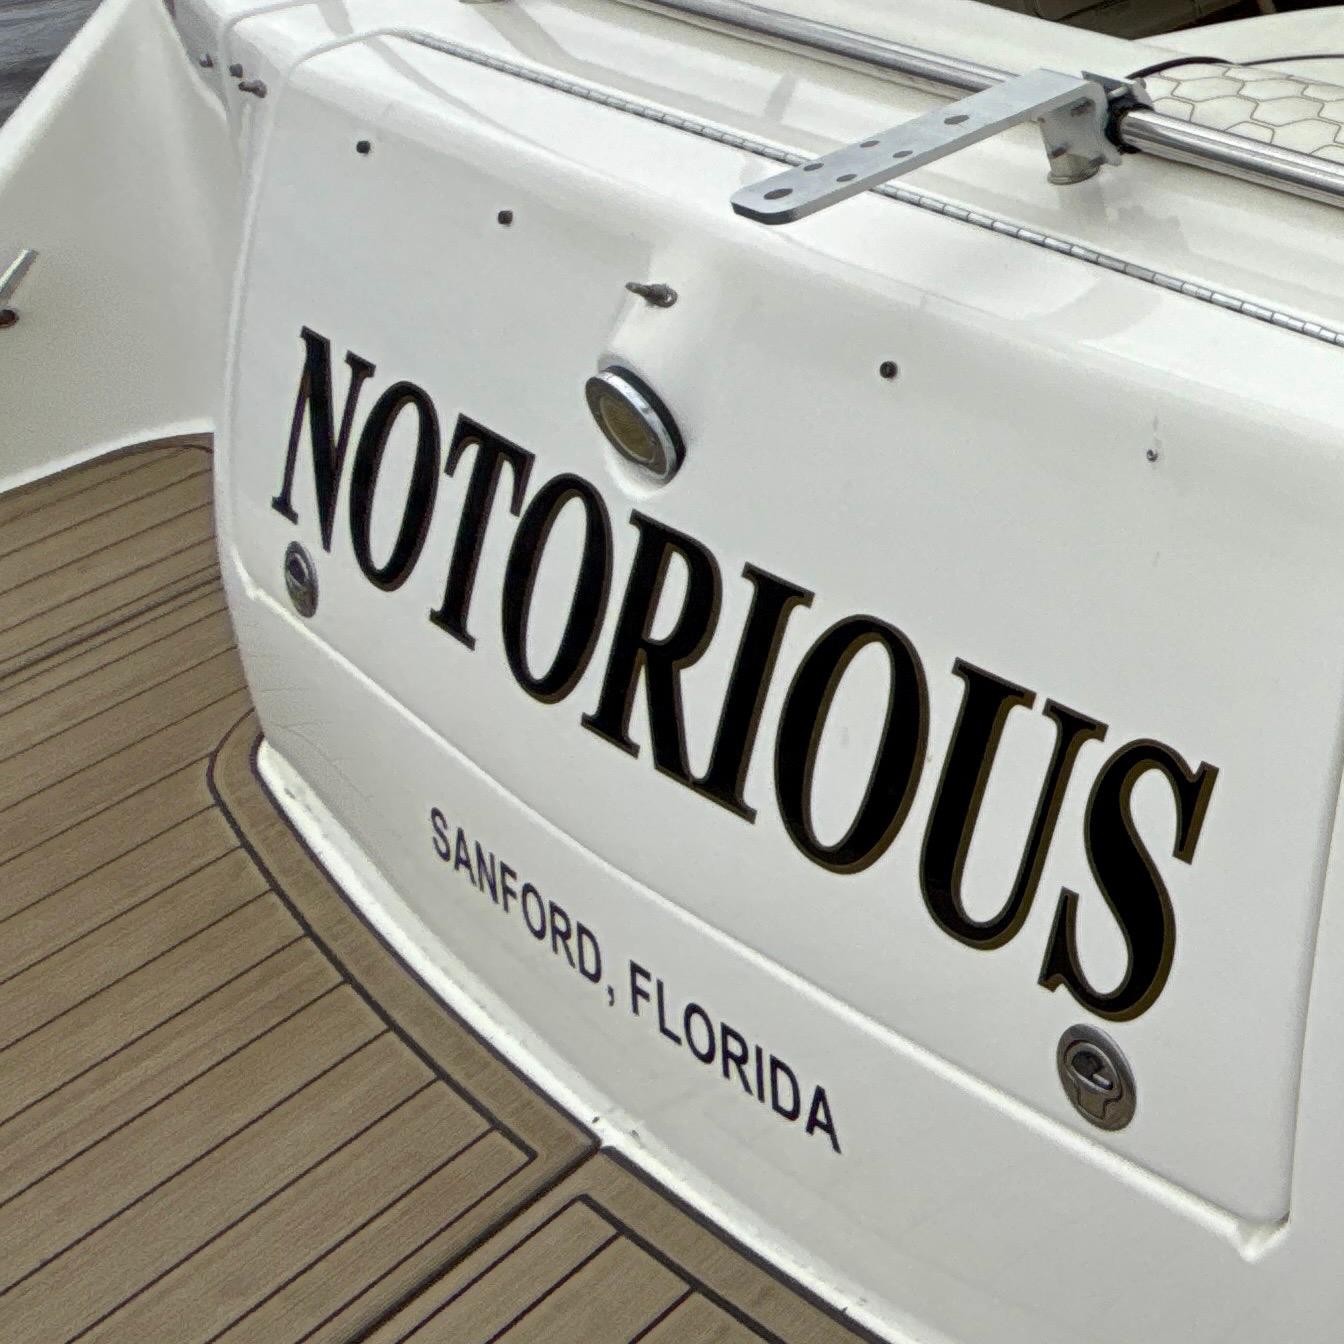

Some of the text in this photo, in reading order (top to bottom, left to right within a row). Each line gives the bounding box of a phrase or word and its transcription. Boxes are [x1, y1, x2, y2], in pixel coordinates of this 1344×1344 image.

[271, 325, 1220, 1023] NOTORIOUS
[430, 807, 843, 1155] SANFORD, FLORIDA
